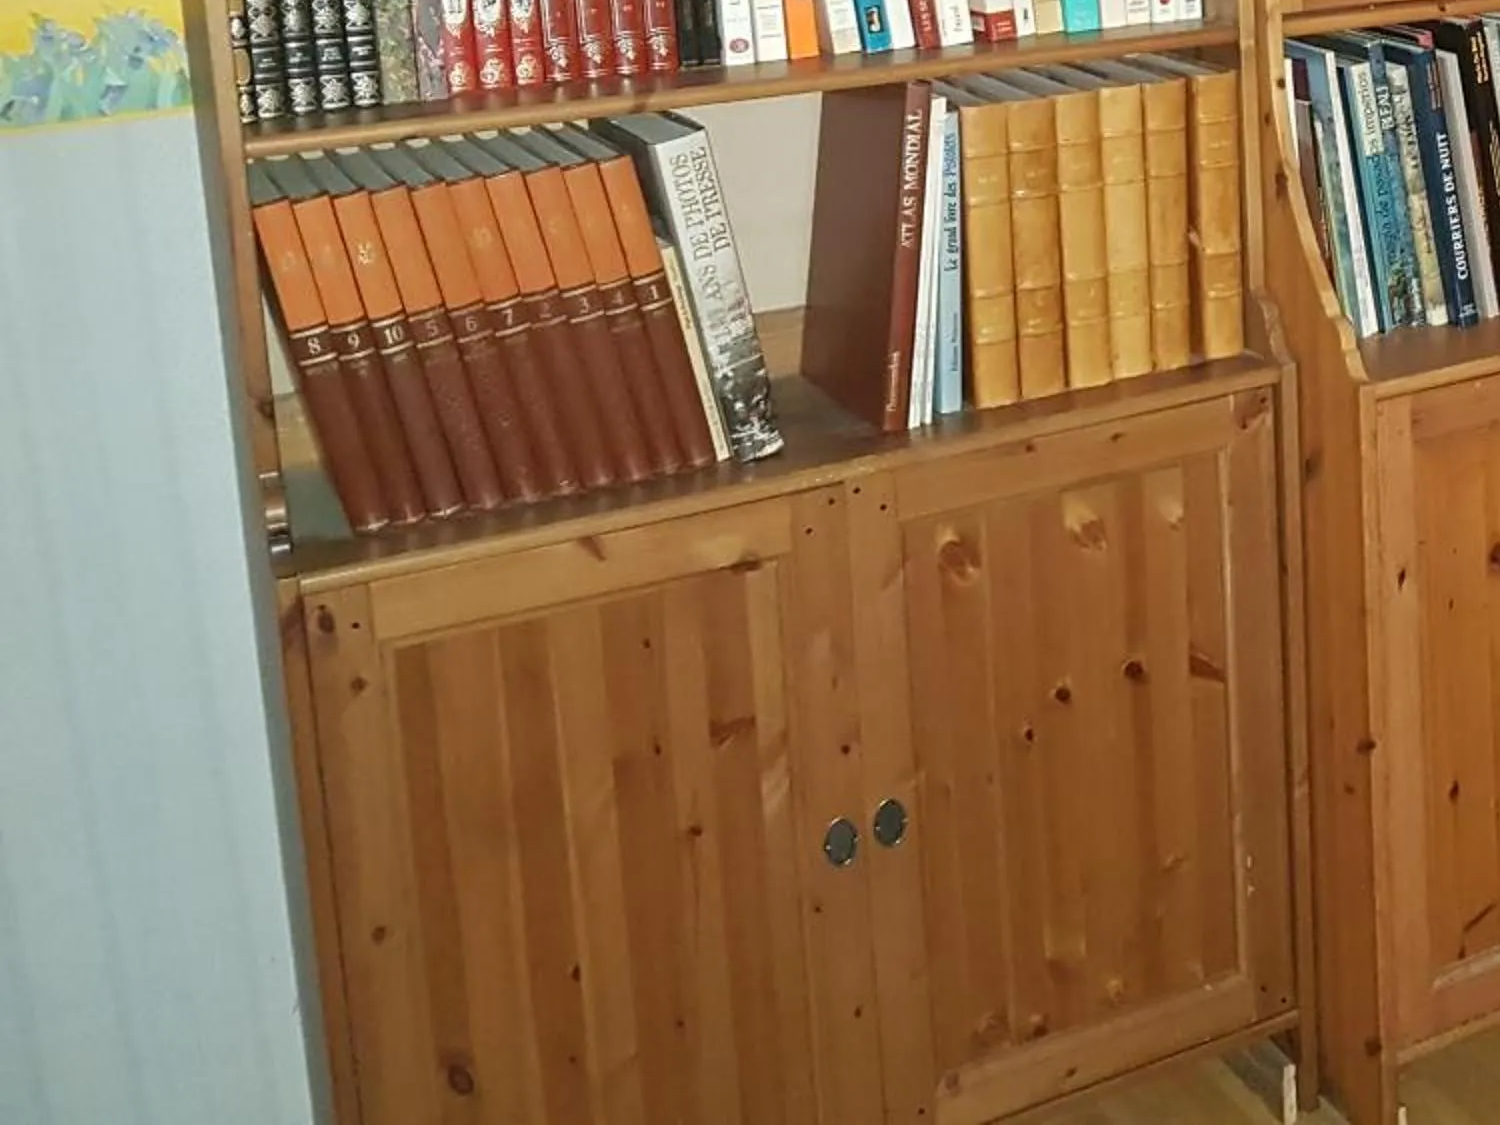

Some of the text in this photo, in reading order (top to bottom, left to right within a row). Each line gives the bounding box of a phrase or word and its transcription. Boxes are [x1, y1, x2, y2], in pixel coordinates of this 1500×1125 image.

[900, 108, 923, 248] ATLAS MONDIAL
[669, 152, 703, 229] PHOTOS
[690, 146, 731, 252] DE PRESSE
[1436, 132, 1470, 280] COURRIERS DE NUIT
[689, 231, 713, 260] DE
[697, 264, 723, 301] ANS
[613, 290, 625, 305] 4
[649, 284, 659, 300] 1
[538, 303, 552, 319] 2
[578, 297, 590, 314] 3
[464, 316, 478, 332] 6
[502, 310, 514, 326] 7
[383, 328, 402, 345] 10
[426, 319, 439, 337] 5
[307, 337, 322, 355] 8
[347, 335, 361, 350] 9
